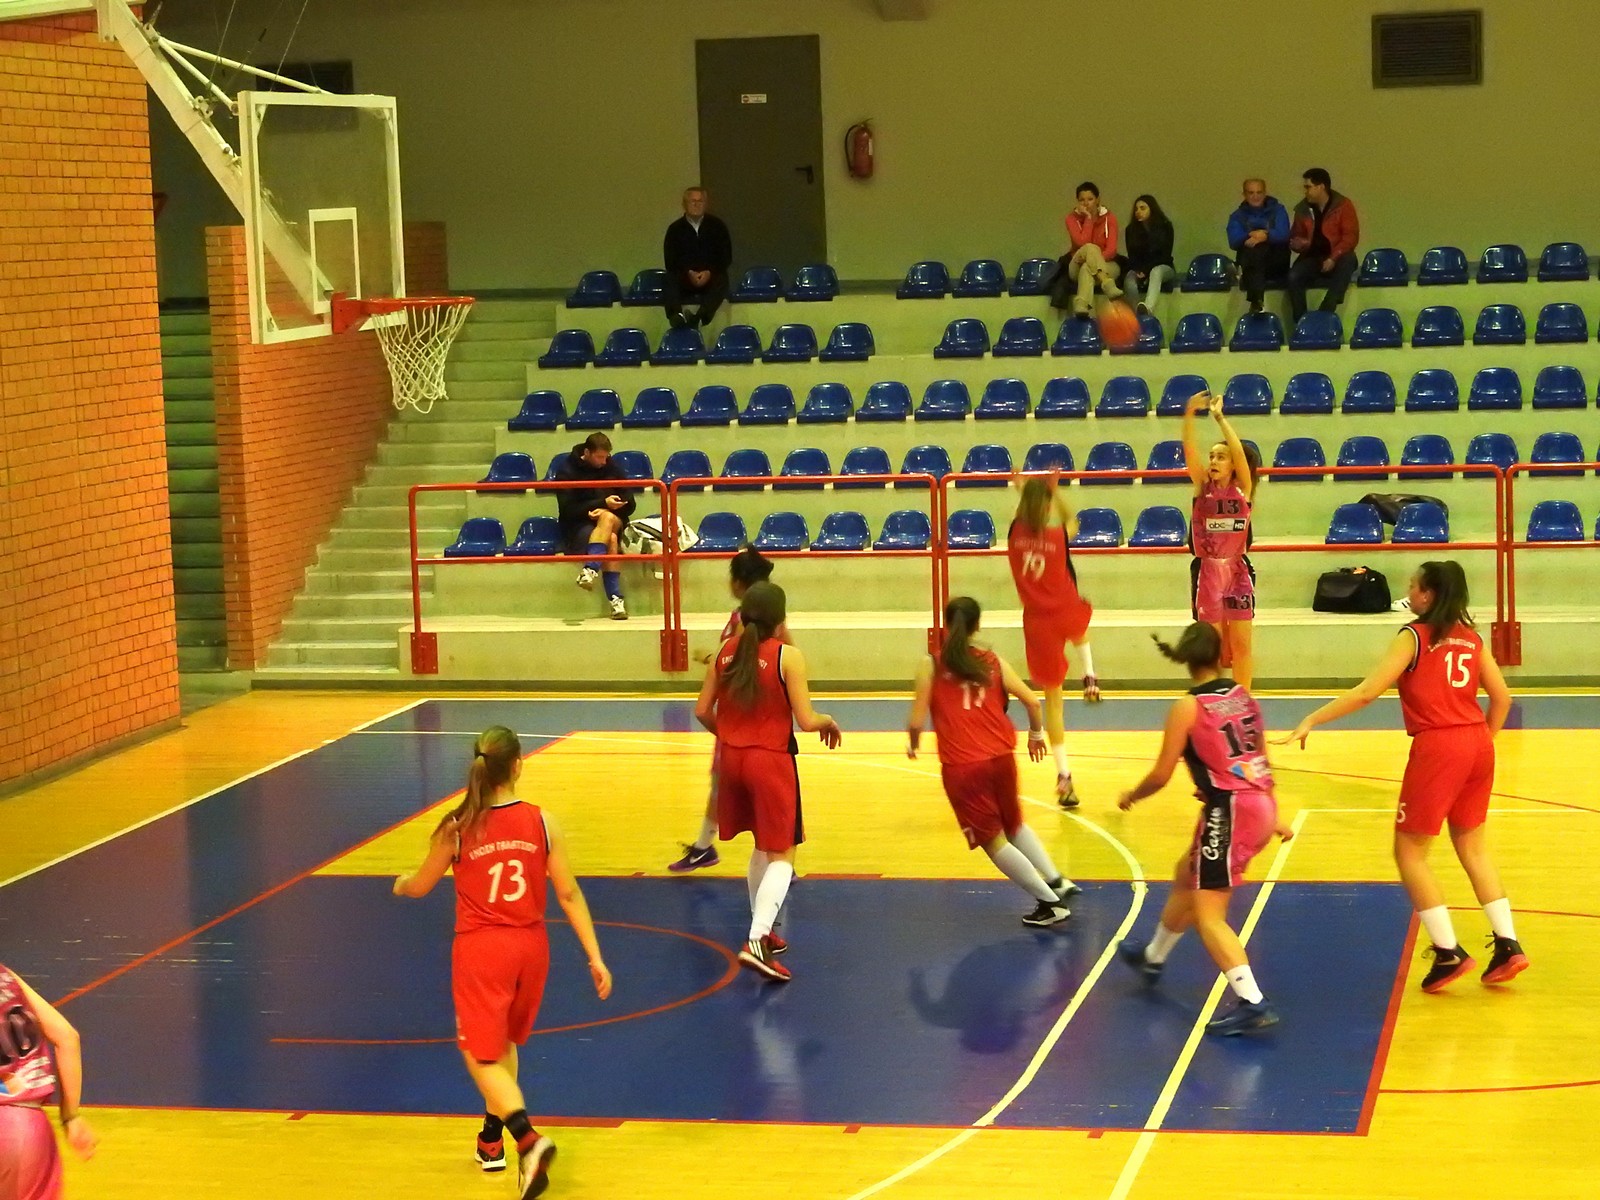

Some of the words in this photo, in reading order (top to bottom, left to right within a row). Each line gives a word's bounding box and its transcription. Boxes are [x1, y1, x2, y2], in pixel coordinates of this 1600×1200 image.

[1215, 498, 1240, 515] 13
[1444, 651, 1473, 688] 15
[1218, 713, 1258, 759] 15
[487, 859, 527, 904] 13
